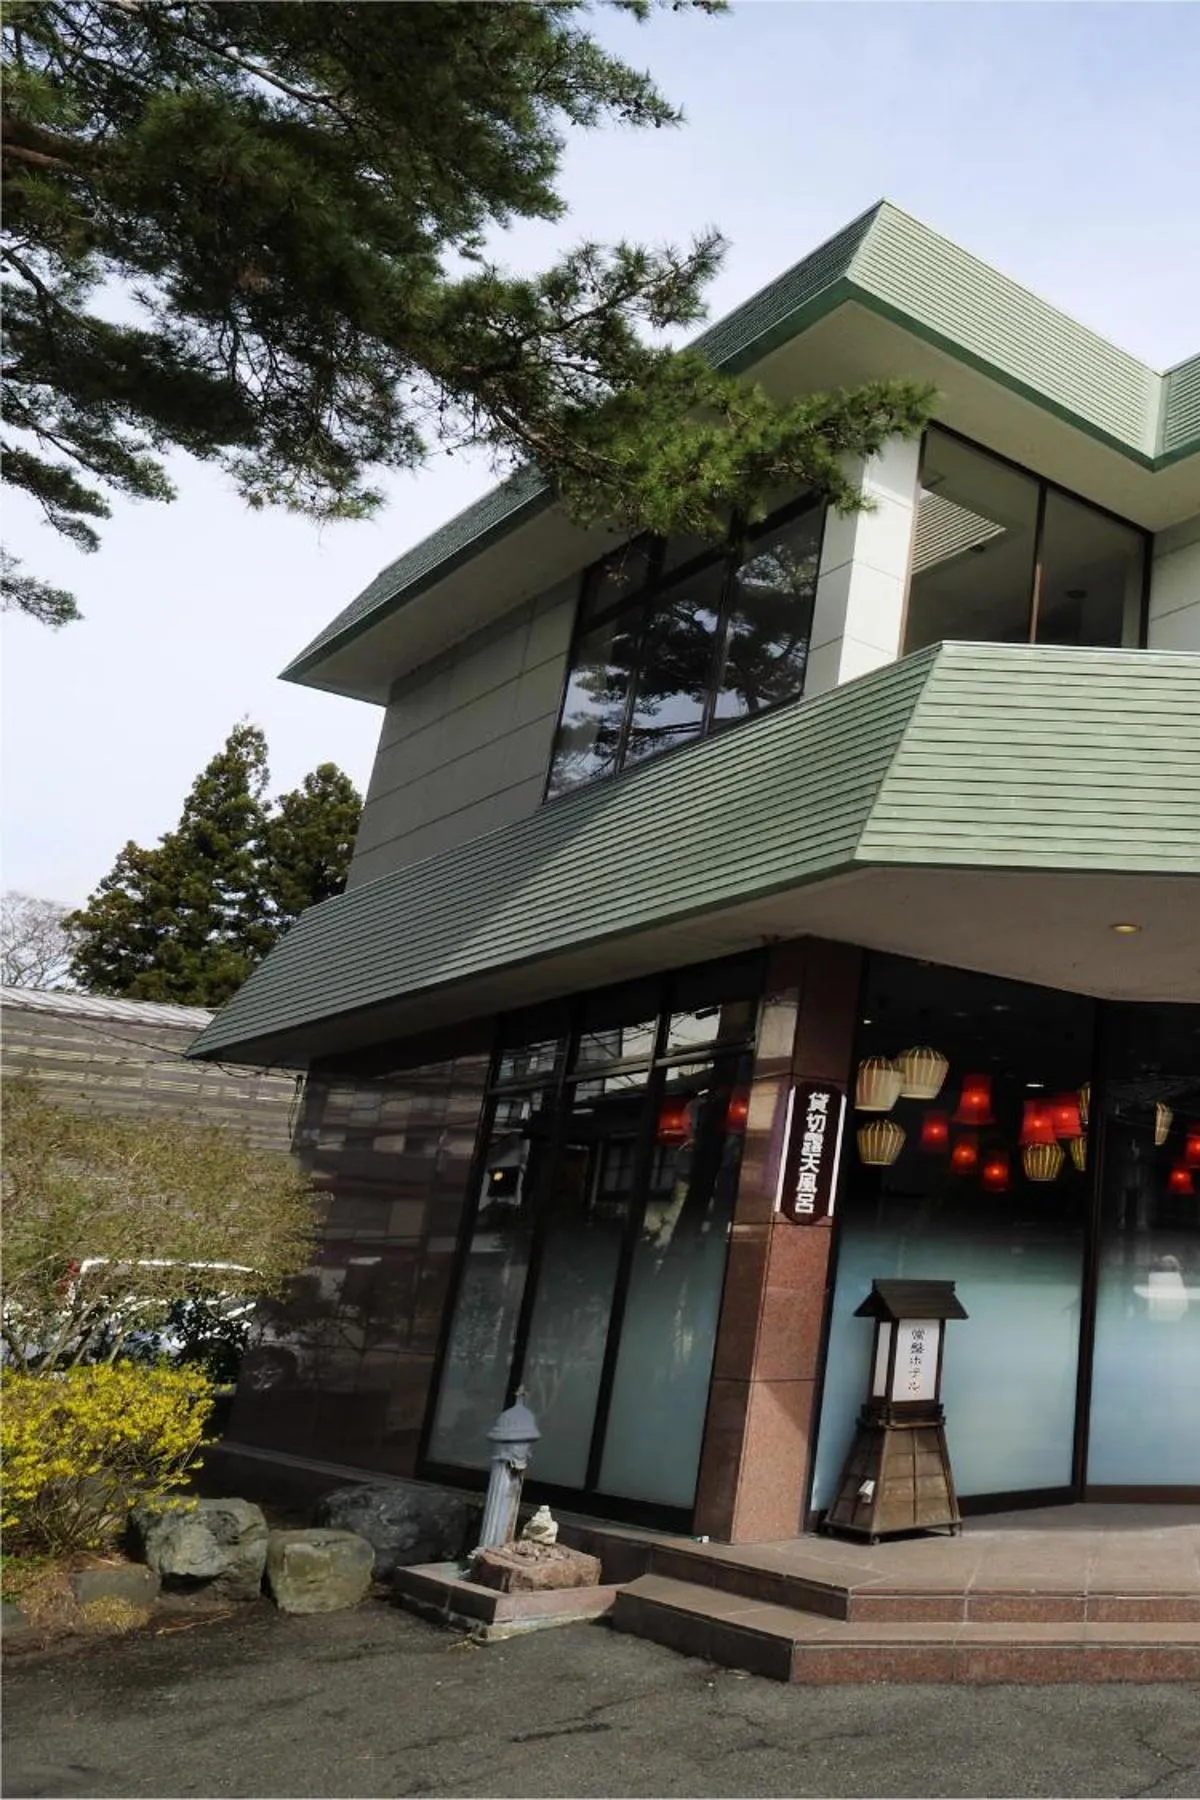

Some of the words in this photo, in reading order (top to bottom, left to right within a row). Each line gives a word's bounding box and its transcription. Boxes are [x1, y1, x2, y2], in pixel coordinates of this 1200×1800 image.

[794, 1092, 830, 1213] 貸切露天風呂
